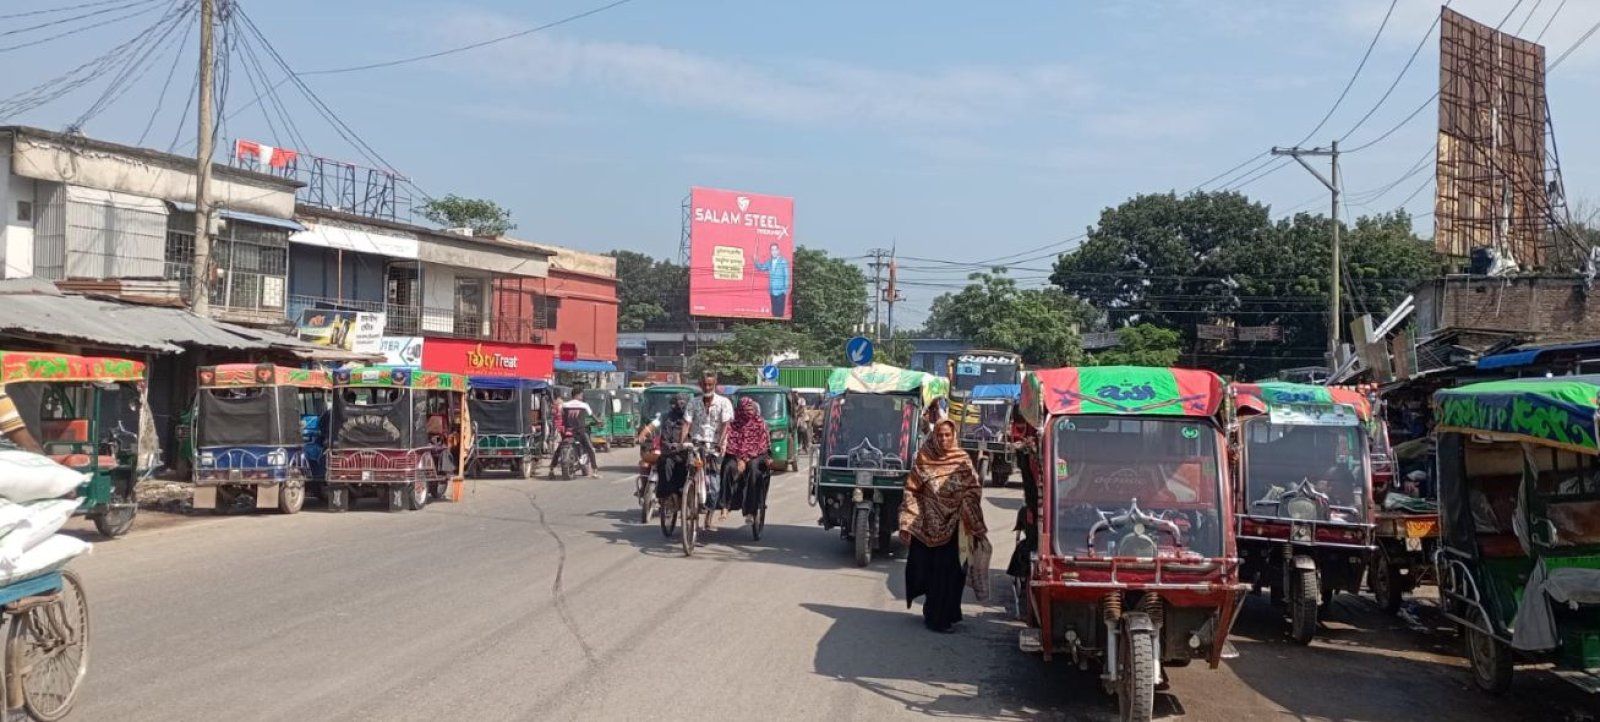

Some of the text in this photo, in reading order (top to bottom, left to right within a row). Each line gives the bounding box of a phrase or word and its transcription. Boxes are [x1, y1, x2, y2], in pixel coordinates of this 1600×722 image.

[695, 208, 780, 229] SALAM STEEL
[957, 354, 1016, 364] Rabbi
